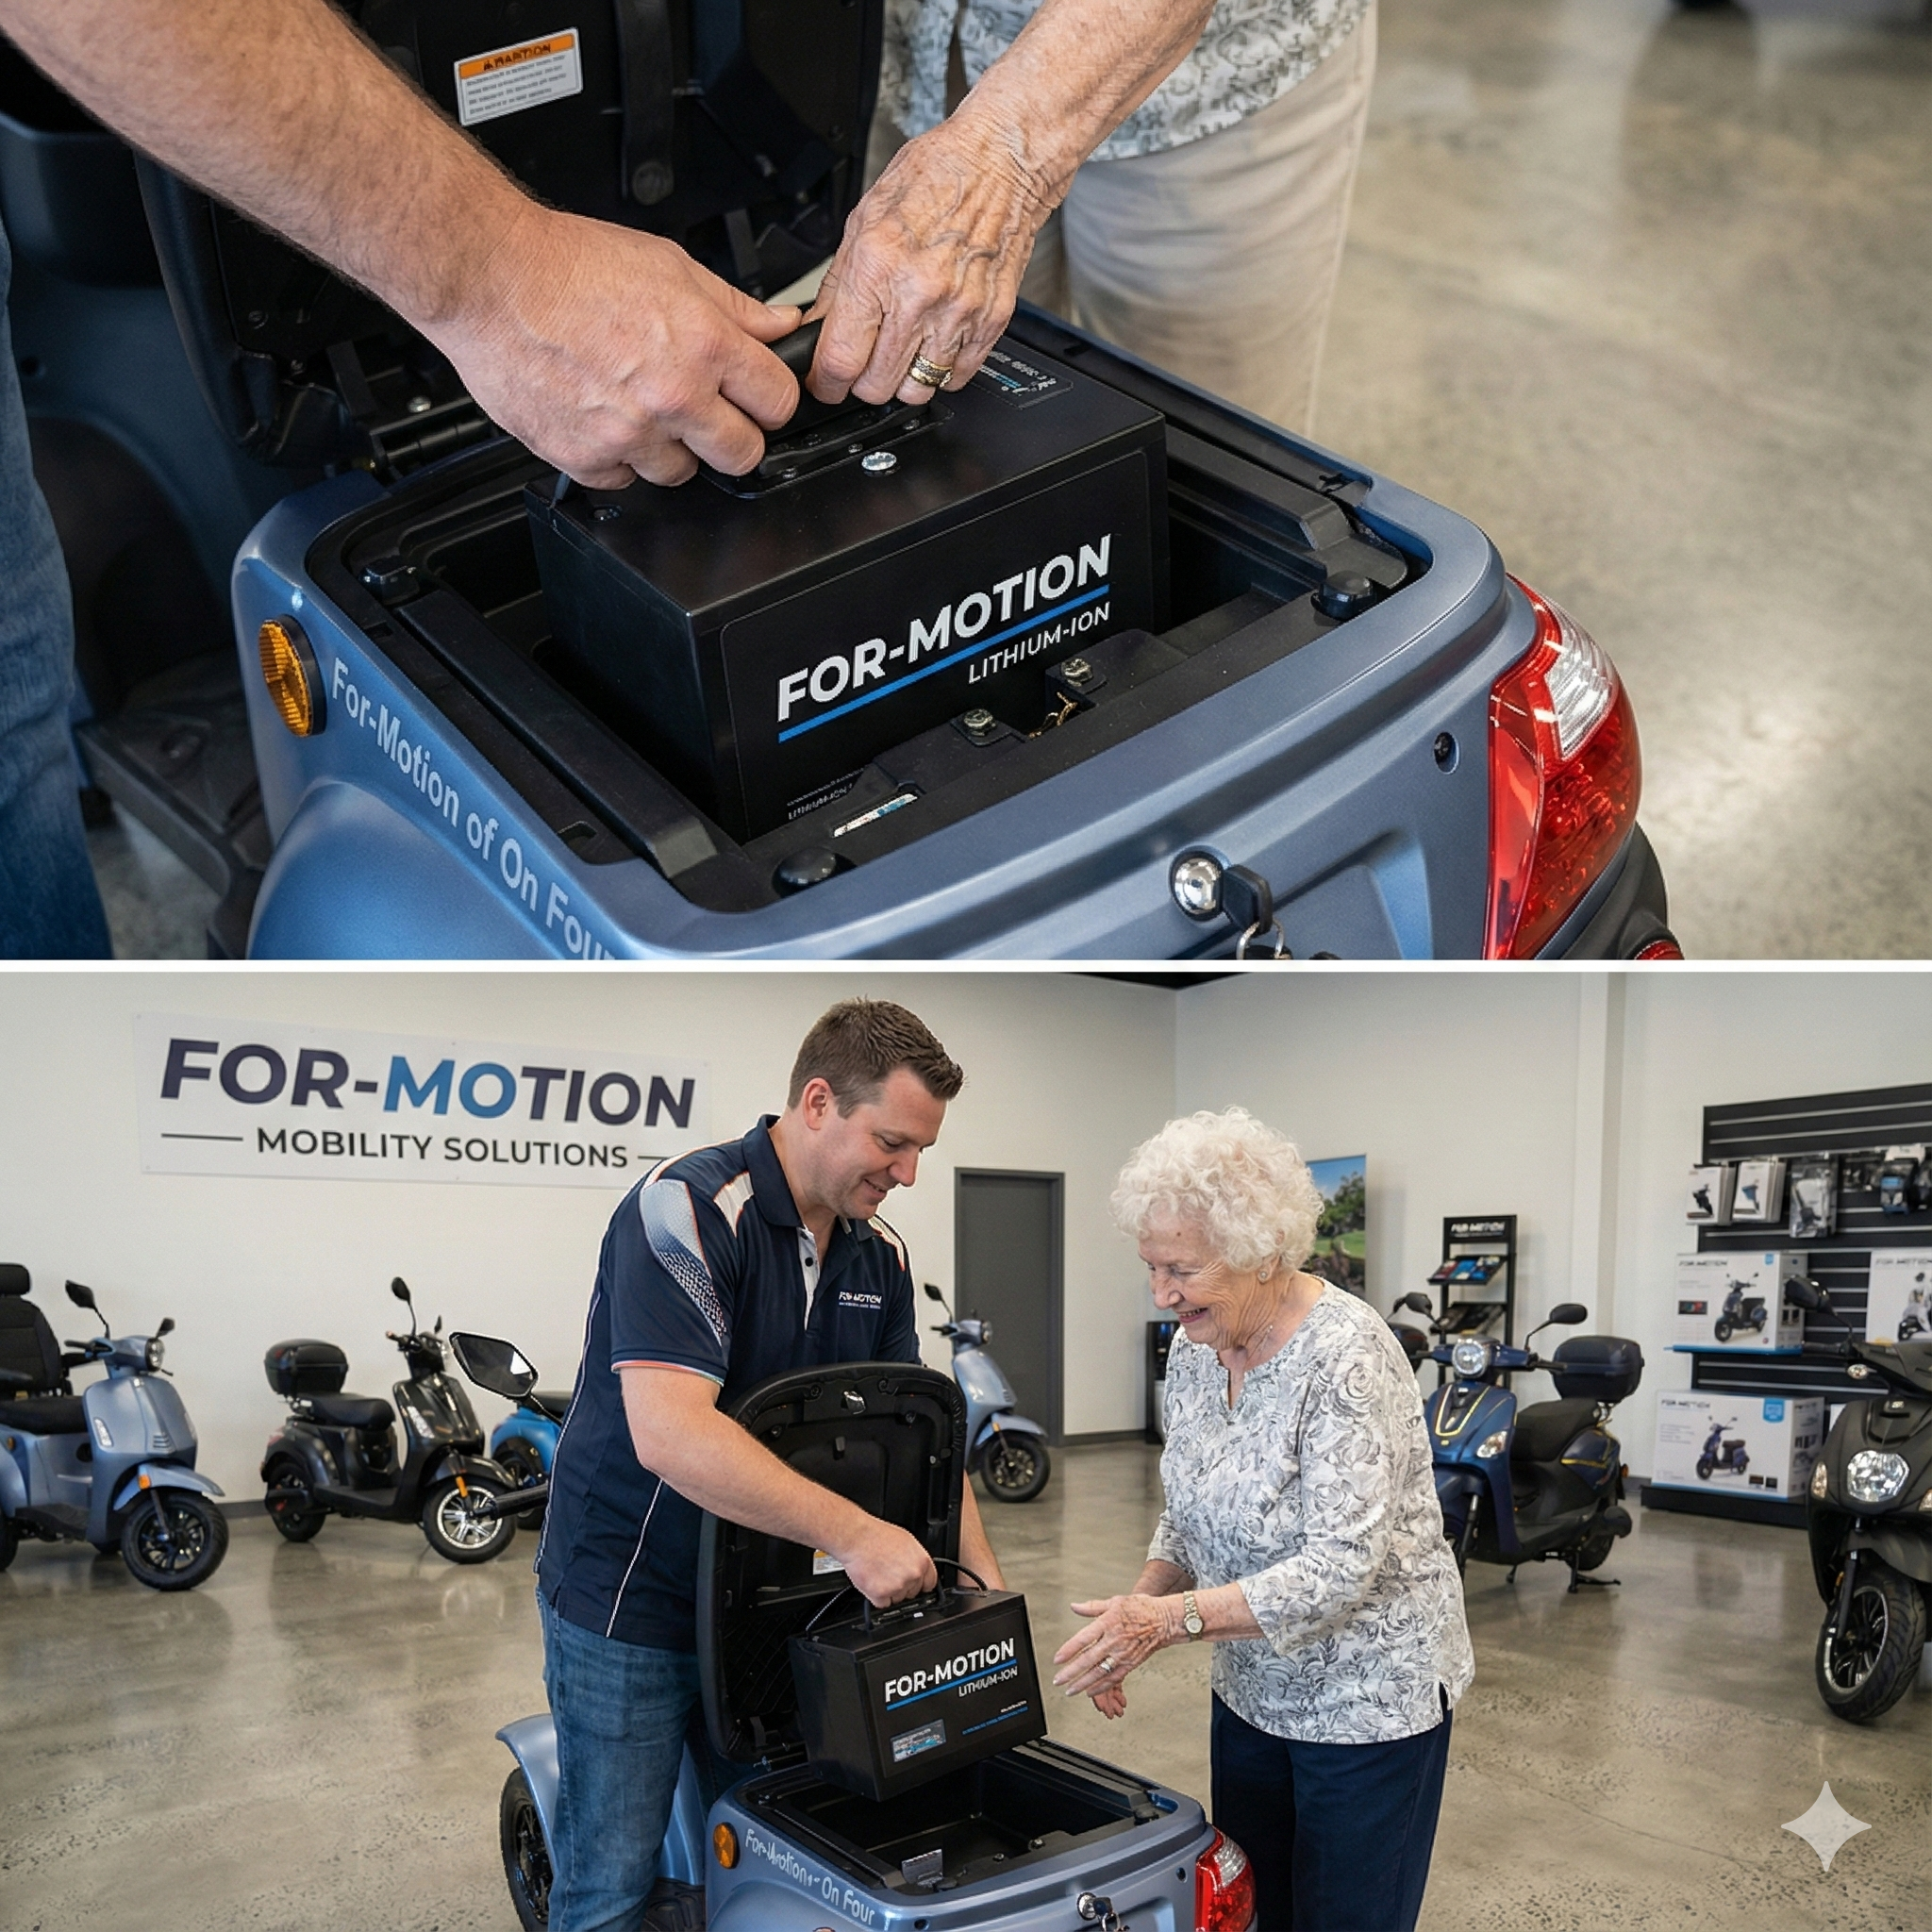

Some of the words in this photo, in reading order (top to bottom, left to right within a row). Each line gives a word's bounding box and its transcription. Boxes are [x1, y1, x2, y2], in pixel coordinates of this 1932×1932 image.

[777, 533, 1111, 723] FOR-MOTION
[968, 602, 1110, 684] LITHIUM-ION
[332, 658, 459, 827] For-Motion
[466, 812, 499, 860] of
[500, 838, 539, 911] On
[160, 1038, 696, 1128] FOR-MOTION
[257, 1127, 433, 1161] MOBILITY
[443, 1137, 628, 1169] SOLUTIONS
[885, 1638, 1014, 1703] FOR-MOTION
[822, 1876, 840, 1906] On
[843, 1890, 875, 1925] Four
